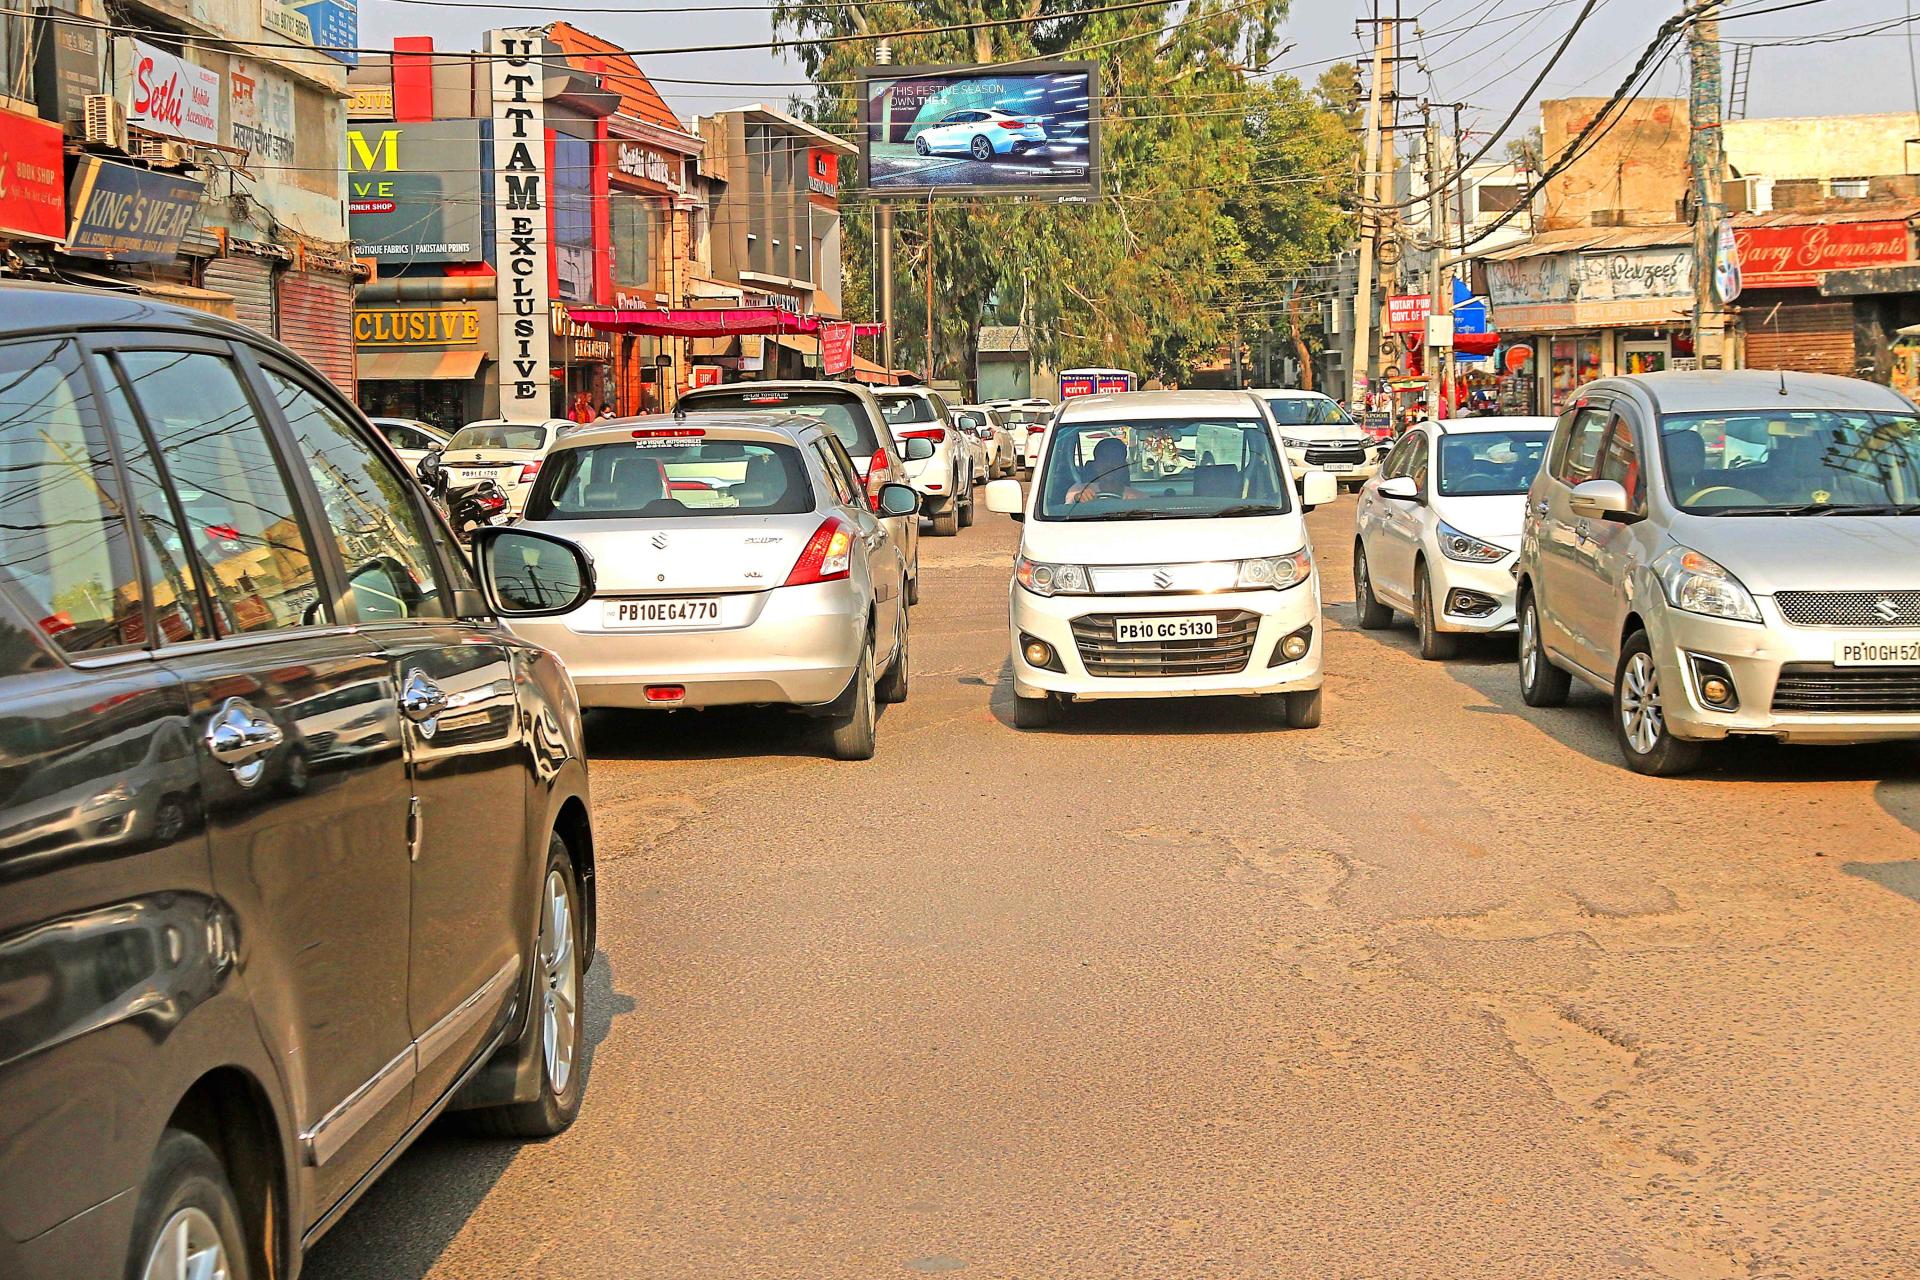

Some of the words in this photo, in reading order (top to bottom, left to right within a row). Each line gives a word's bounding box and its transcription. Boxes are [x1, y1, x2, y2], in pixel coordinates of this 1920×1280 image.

[135, 57, 184, 126] Sethi
[192, 86, 210, 107] Mobile
[891, 86, 914, 96] THIS
[916, 86, 957, 96] FESTIVE
[891, 97, 915, 106] OWN
[917, 96, 939, 106] THE
[501, 39, 541, 210] UTTAM
[16, 161, 36, 182] BOOK
[36, 166, 55, 186] SHOP
[372, 203, 393, 211] SHOP
[143, 200, 193, 238] WEAR
[383, 244, 409, 255] FABRICS
[415, 243, 447, 254] PAKISTANI
[447, 243, 470, 253] PRINTS
[1796, 225, 1905, 267] Garments
[509, 217, 537, 399] EXCLUSIVE
[1389, 299, 1415, 310] NOTARY
[1391, 311, 1411, 322] GOVT.
[1411, 310, 1421, 320] OF
[354, 312, 480, 341] CLUSIVE
[1065, 386, 1089, 394] KITTY
[619, 602, 718, 620] PB10EG4770
[1120, 624, 1153, 638] PB10
[1157, 623, 1176, 637] GC
[1179, 622, 1213, 636] 5130
